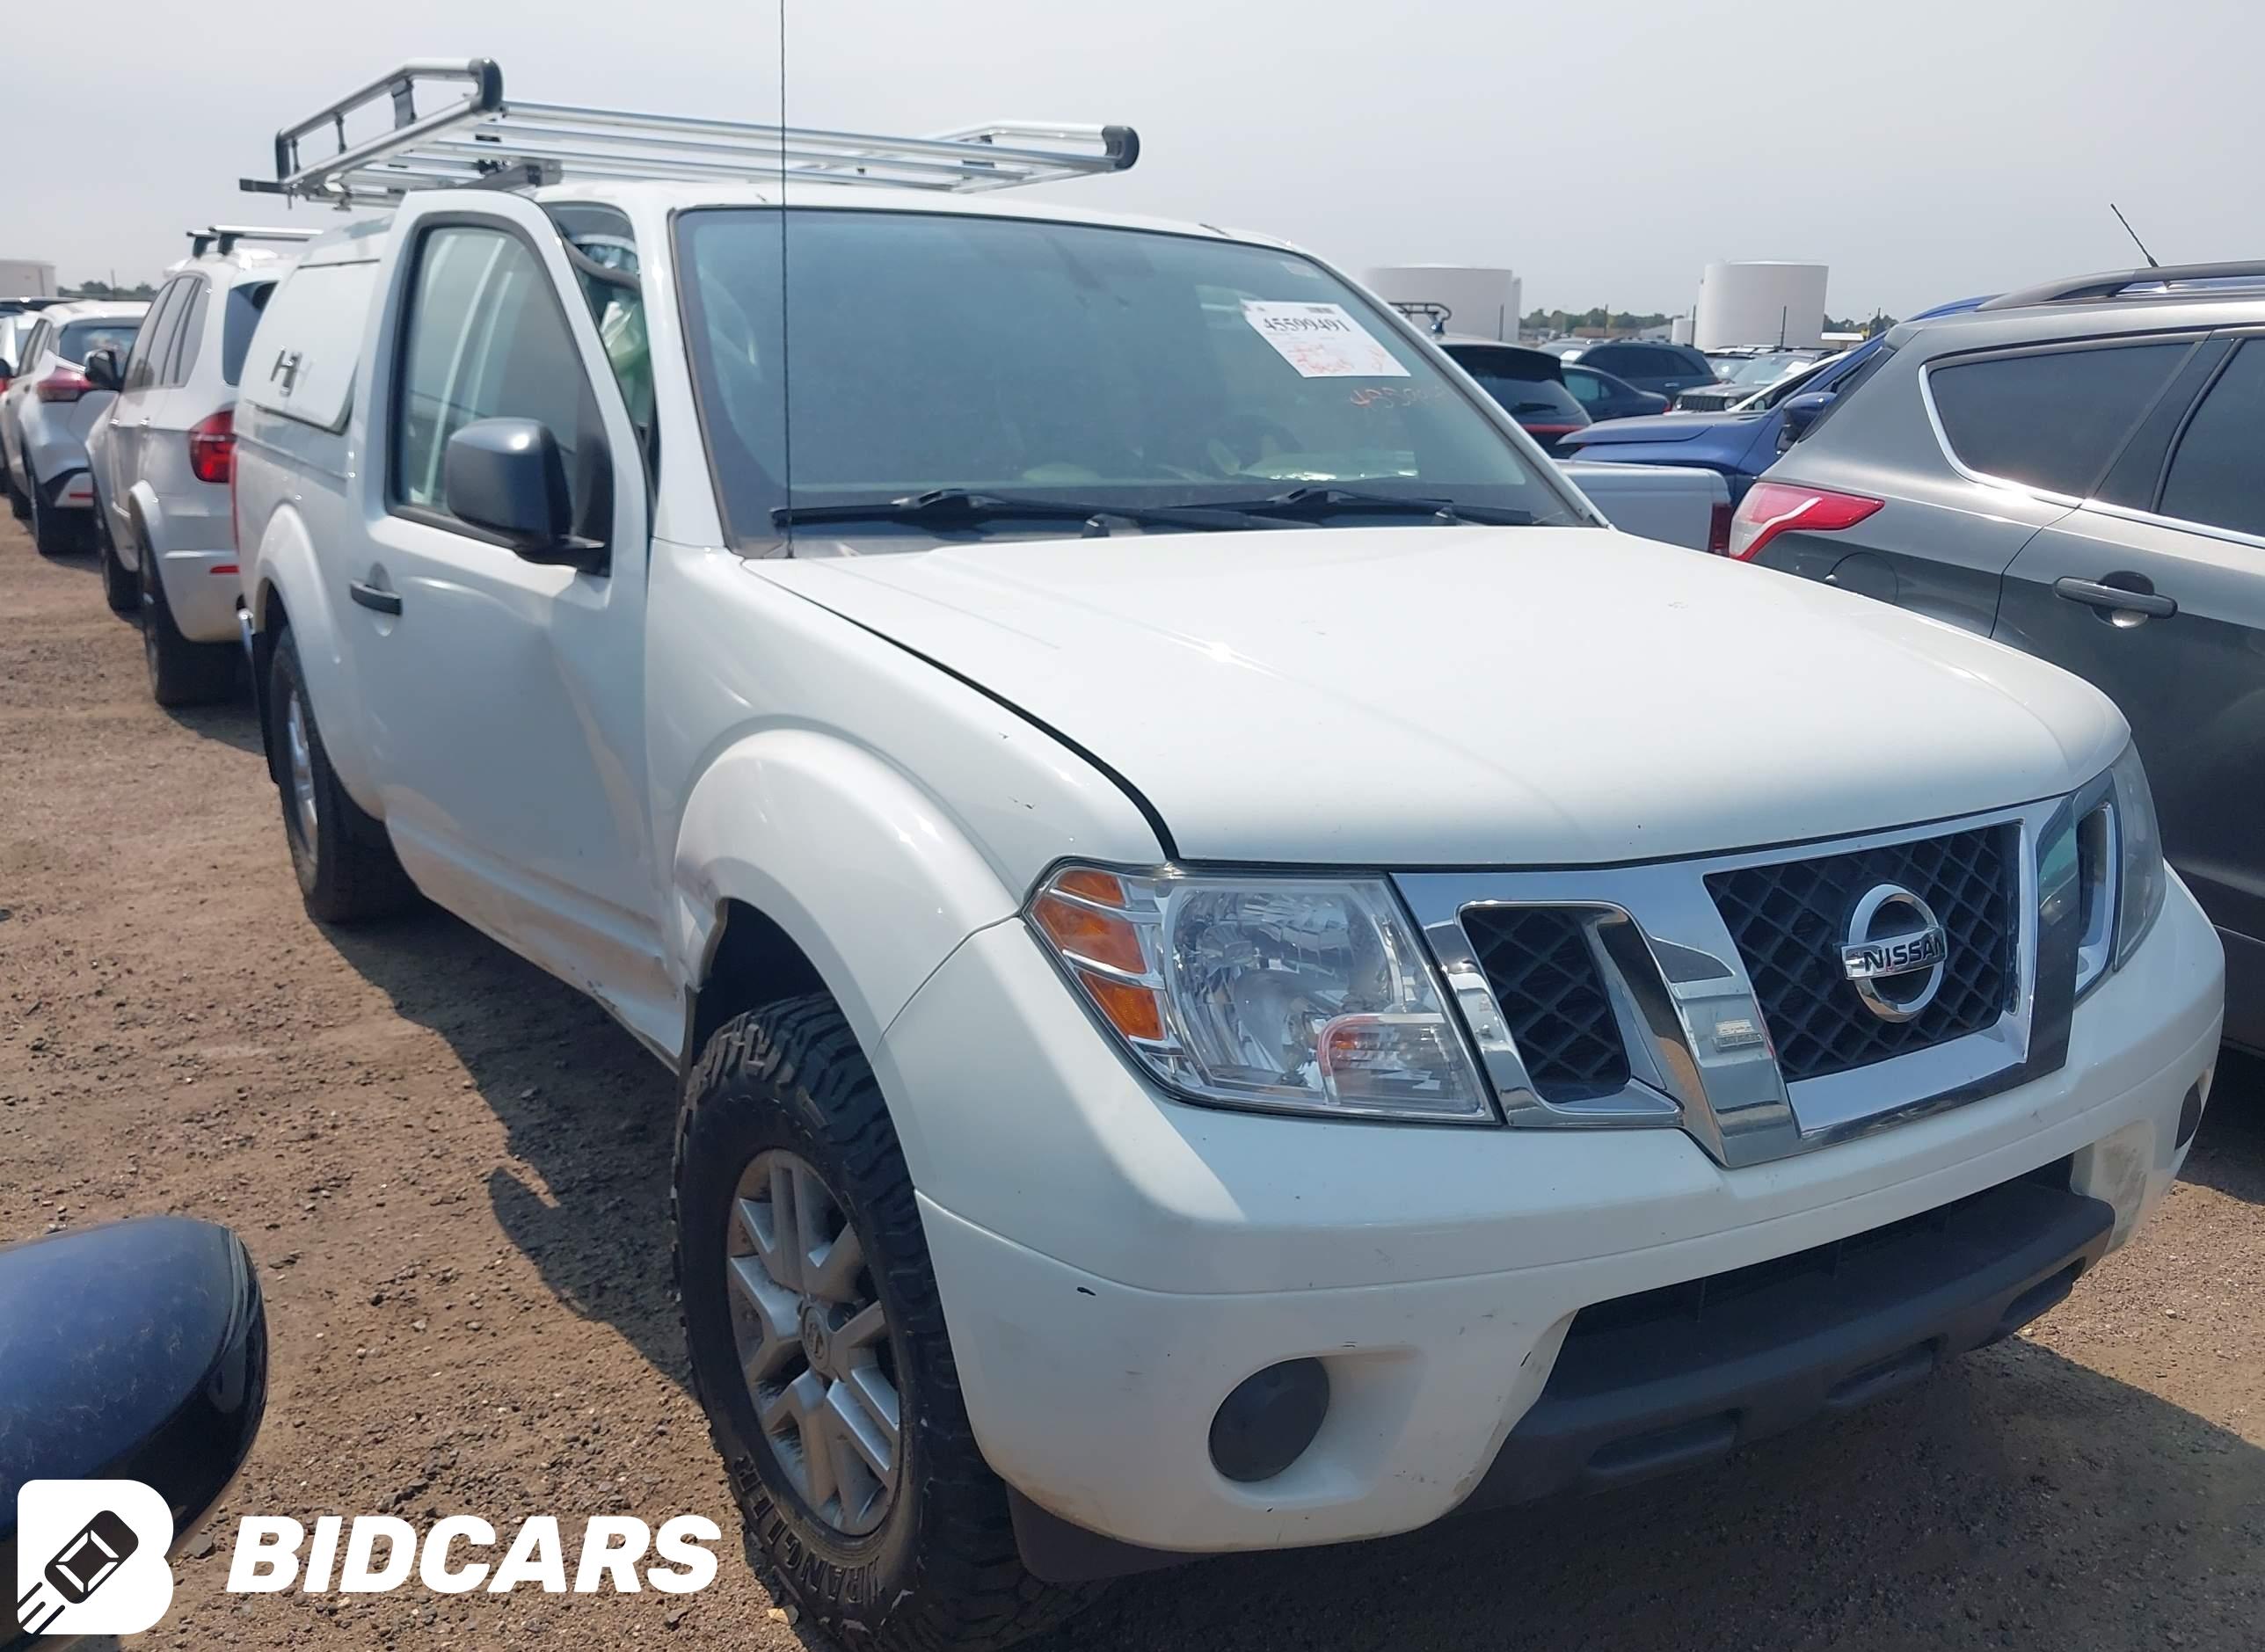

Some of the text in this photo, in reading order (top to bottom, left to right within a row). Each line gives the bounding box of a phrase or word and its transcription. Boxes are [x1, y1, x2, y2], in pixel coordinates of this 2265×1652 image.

[1263, 317, 1351, 332] 45599491
[1863, 935, 1943, 972] NISSAN
[732, 1454, 880, 1605] WRANGLER
